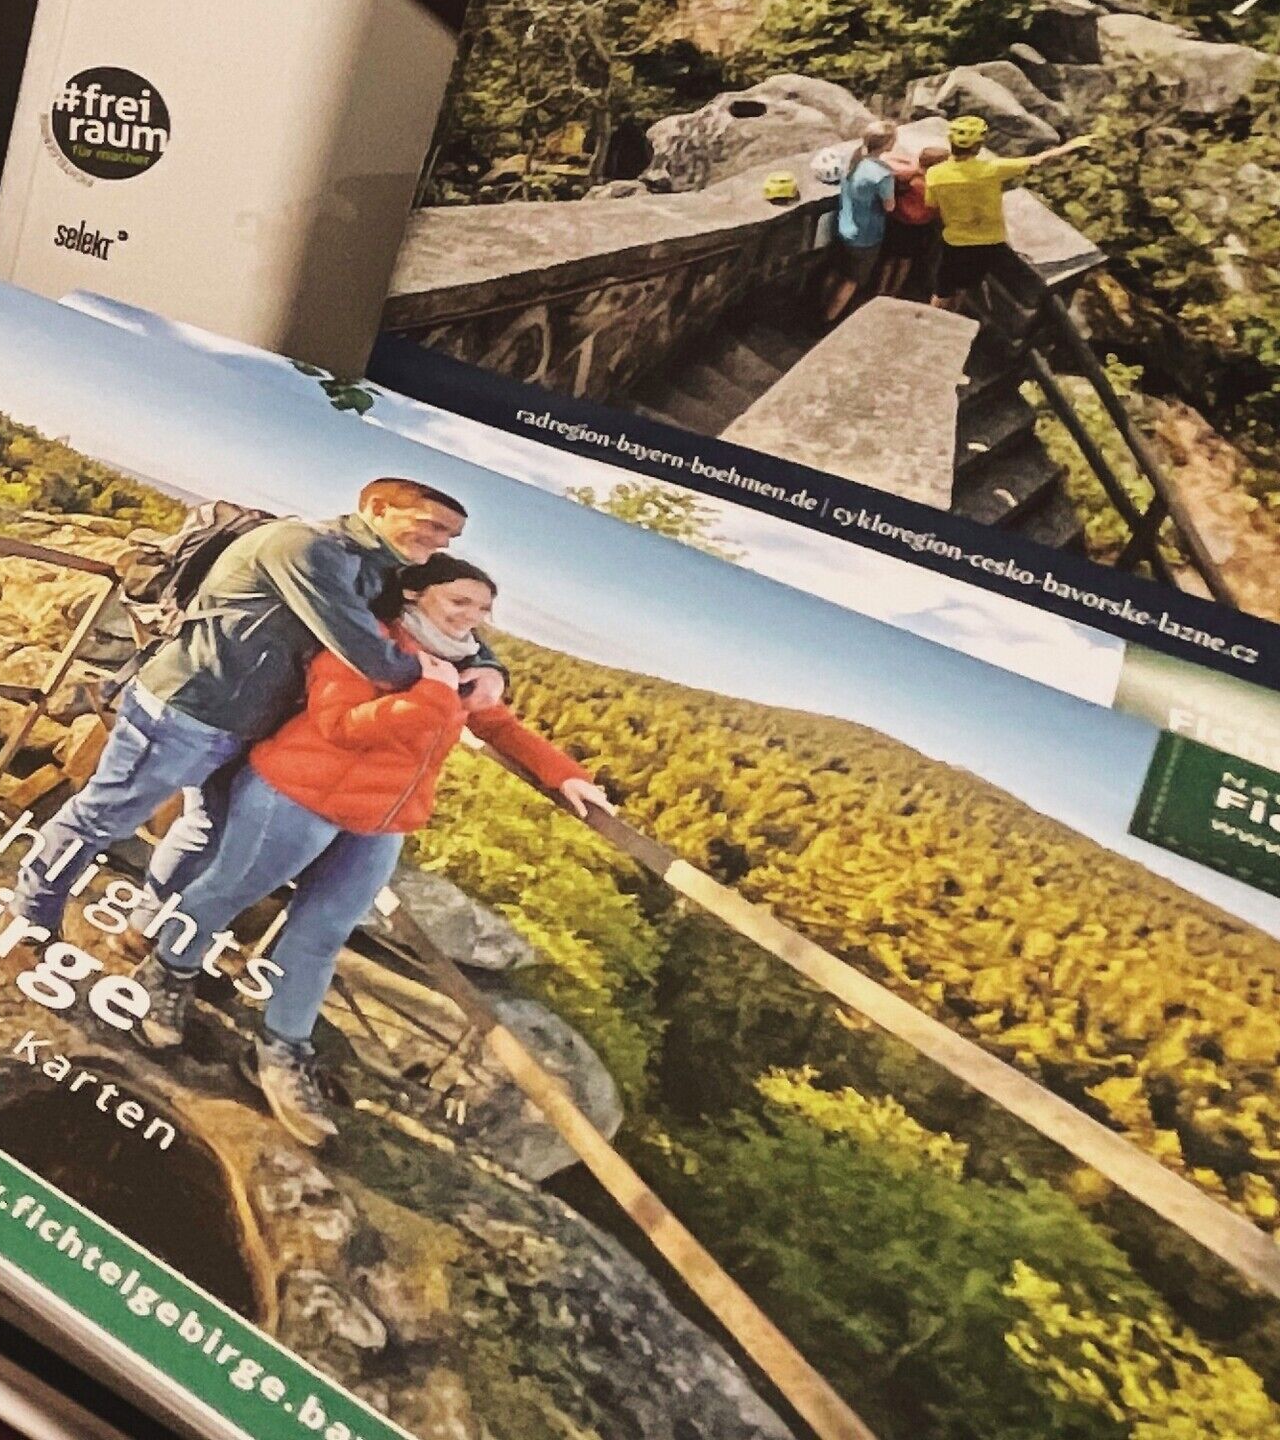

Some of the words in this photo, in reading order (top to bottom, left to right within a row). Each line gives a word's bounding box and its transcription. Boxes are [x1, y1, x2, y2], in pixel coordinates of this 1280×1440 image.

[54, 81, 152, 124] #frei
[68, 115, 169, 153] raum
[513, 404, 821, 513] radregion-bayern-boehmen.de
[831, 505, 1262, 666] cykloregion-cesko-bavorske-lazne.cz
[12, 1029, 178, 1153] Karten
